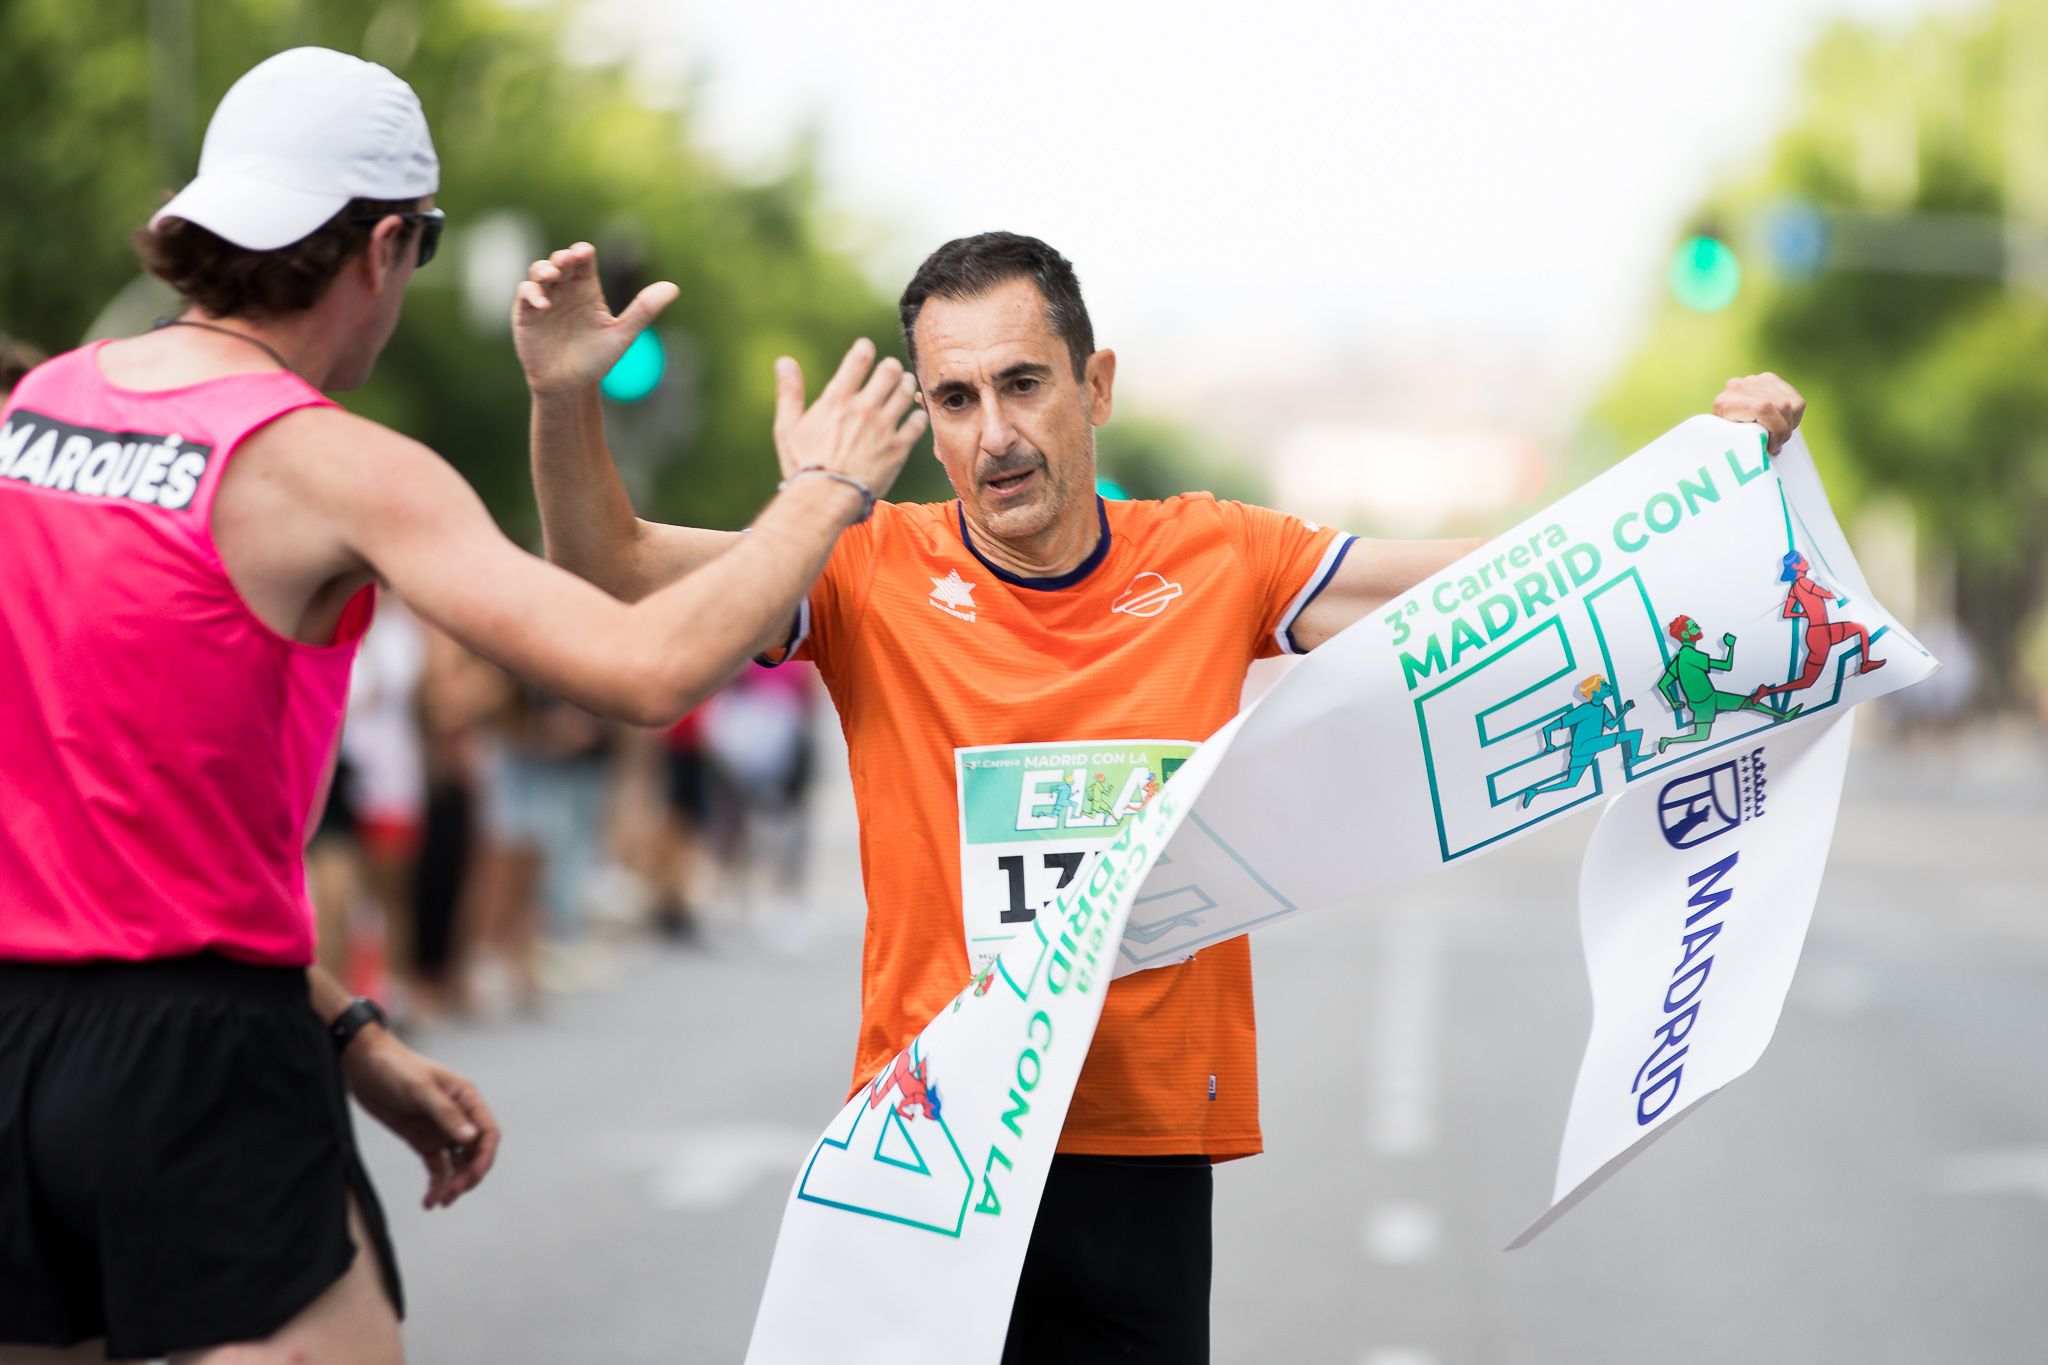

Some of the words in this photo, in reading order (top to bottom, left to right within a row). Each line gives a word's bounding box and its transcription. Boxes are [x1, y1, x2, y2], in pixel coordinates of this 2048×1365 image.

[0, 421, 206, 509] MARQUÉS
[1398, 542, 1602, 691] MADRID
[1613, 465, 1721, 553] CON
[1432, 523, 1568, 614] Carrera
[1015, 767, 1154, 832] ELA
[1024, 753, 1088, 769] MADRID
[1092, 751, 1126, 765] CON
[1129, 751, 1149, 764] LA
[1631, 850, 1740, 1126] MADRID
[1000, 1010, 1053, 1139] CON
[975, 1144, 1014, 1217] LA
